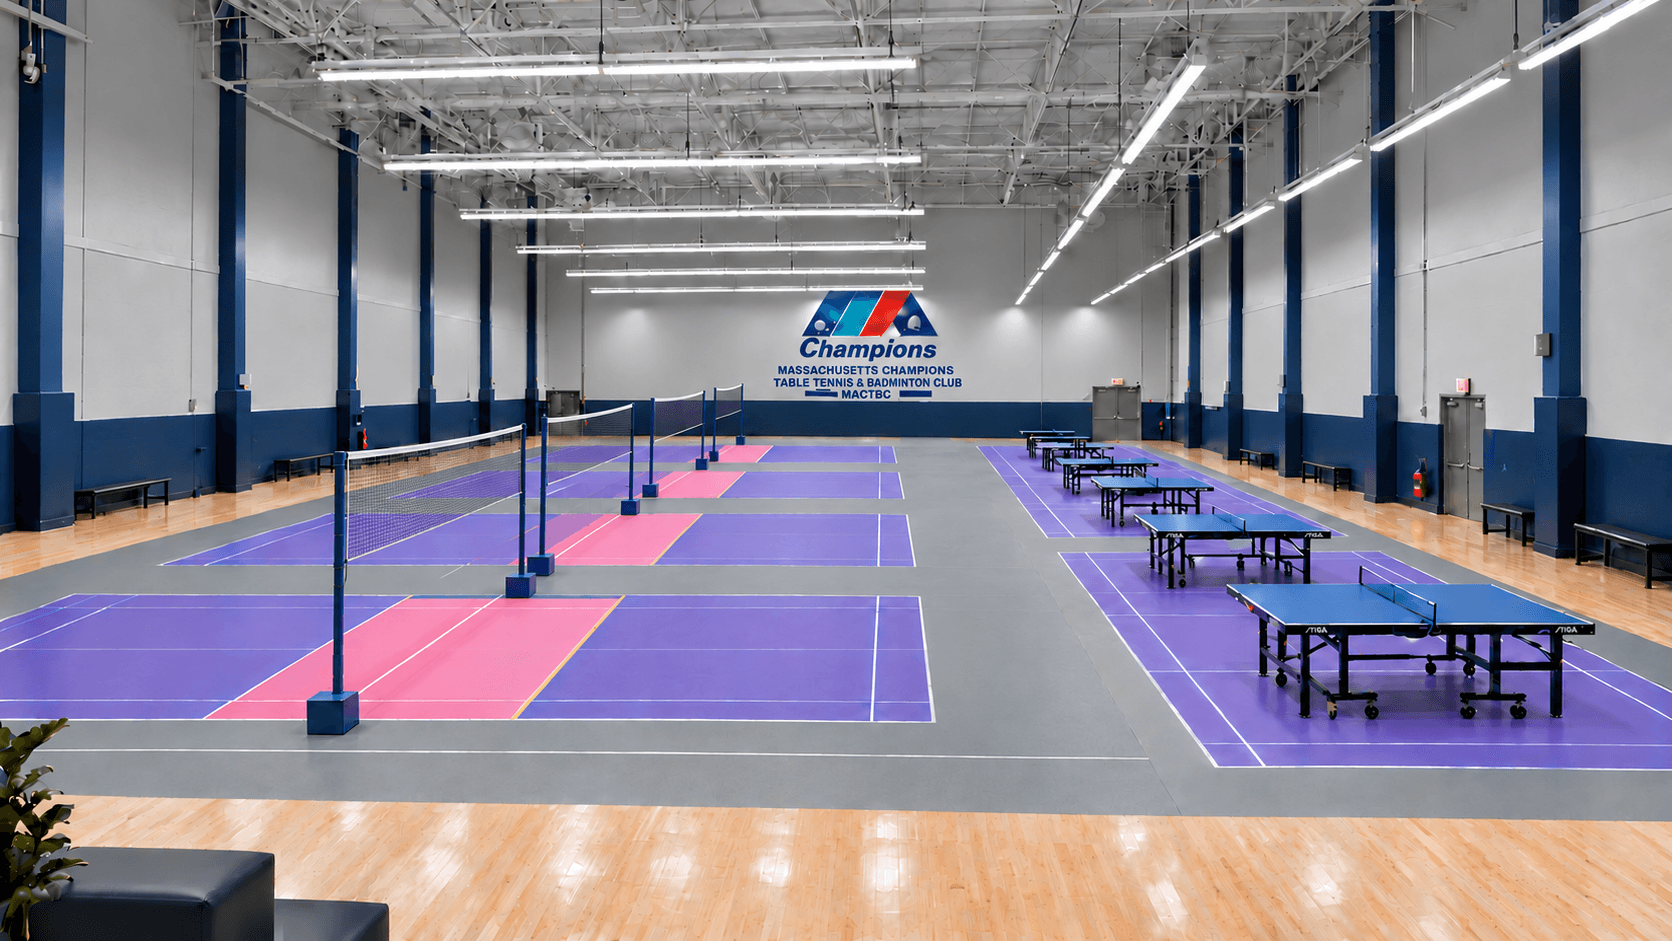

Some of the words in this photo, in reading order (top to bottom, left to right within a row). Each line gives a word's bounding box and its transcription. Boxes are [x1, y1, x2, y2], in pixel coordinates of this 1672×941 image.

[799, 337, 937, 362] Champions
[778, 365, 879, 376] MASSACHUSETTS
[882, 365, 955, 376] CHAMPIONS
[773, 377, 810, 388] TABLE
[813, 377, 854, 388] TENNIS
[856, 377, 865, 388] &
[867, 377, 931, 388] BADMINTON
[933, 377, 963, 388] CLUB
[841, 389, 892, 400] MACTBC
[1554, 626, 1579, 634] STIGA
